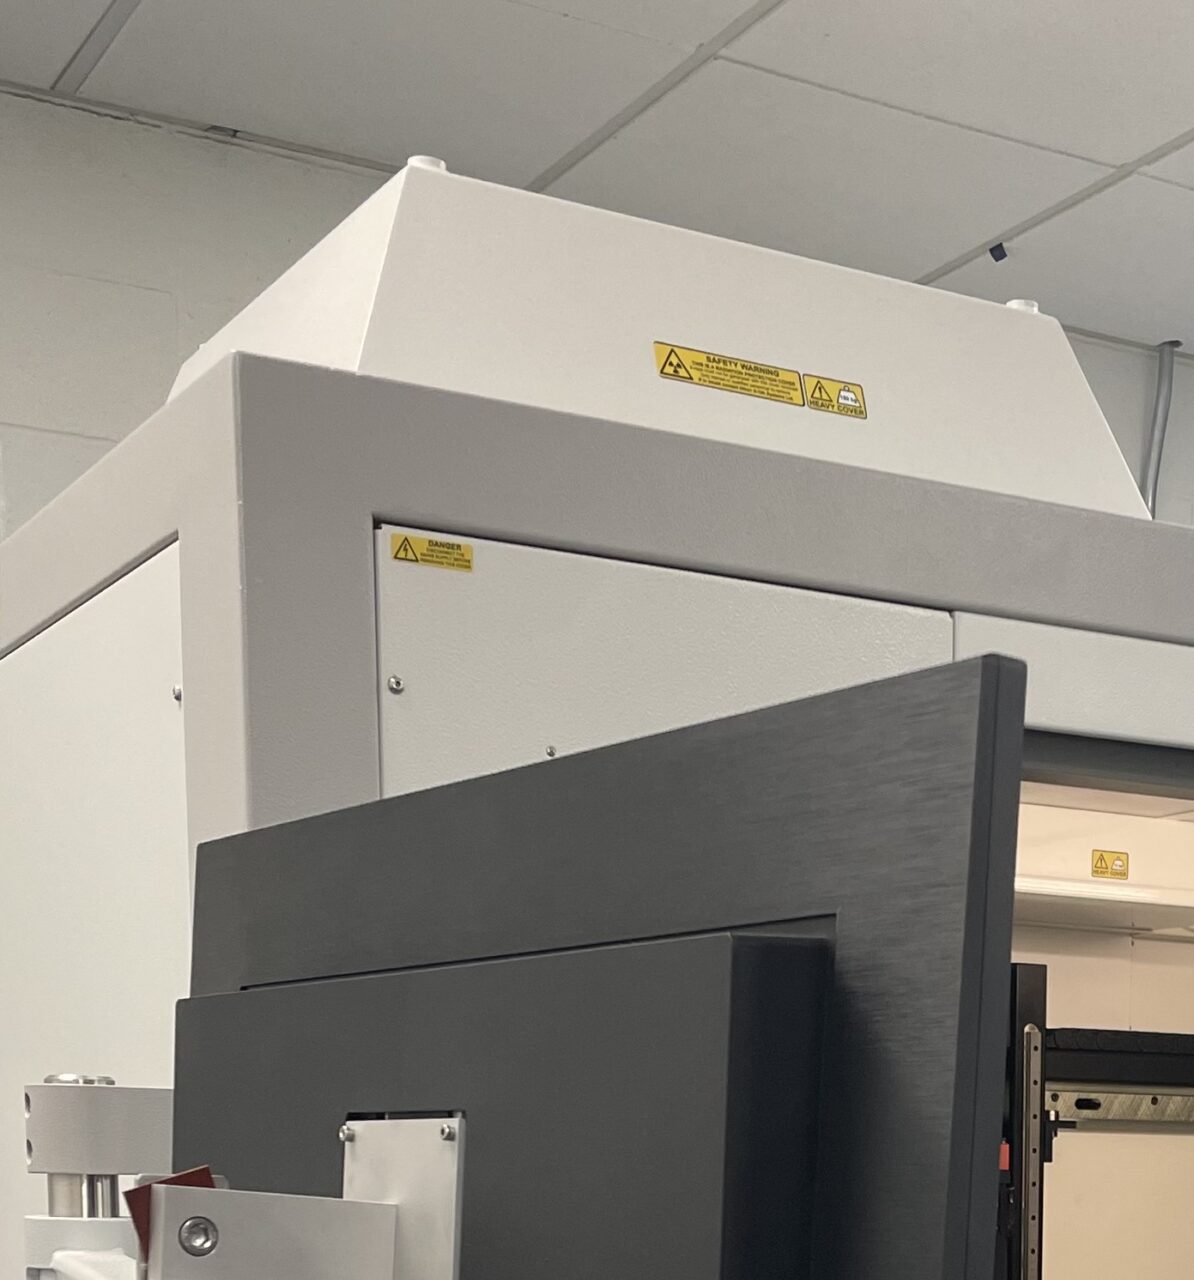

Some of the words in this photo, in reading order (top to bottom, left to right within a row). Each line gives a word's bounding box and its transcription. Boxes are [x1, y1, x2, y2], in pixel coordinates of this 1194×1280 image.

[705, 355, 738, 368] SAFETY
[740, 362, 780, 377] WARNING
[809, 399, 835, 411] HEAVY
[837, 405, 864, 416] COVER
[428, 540, 462, 551] DANGER
